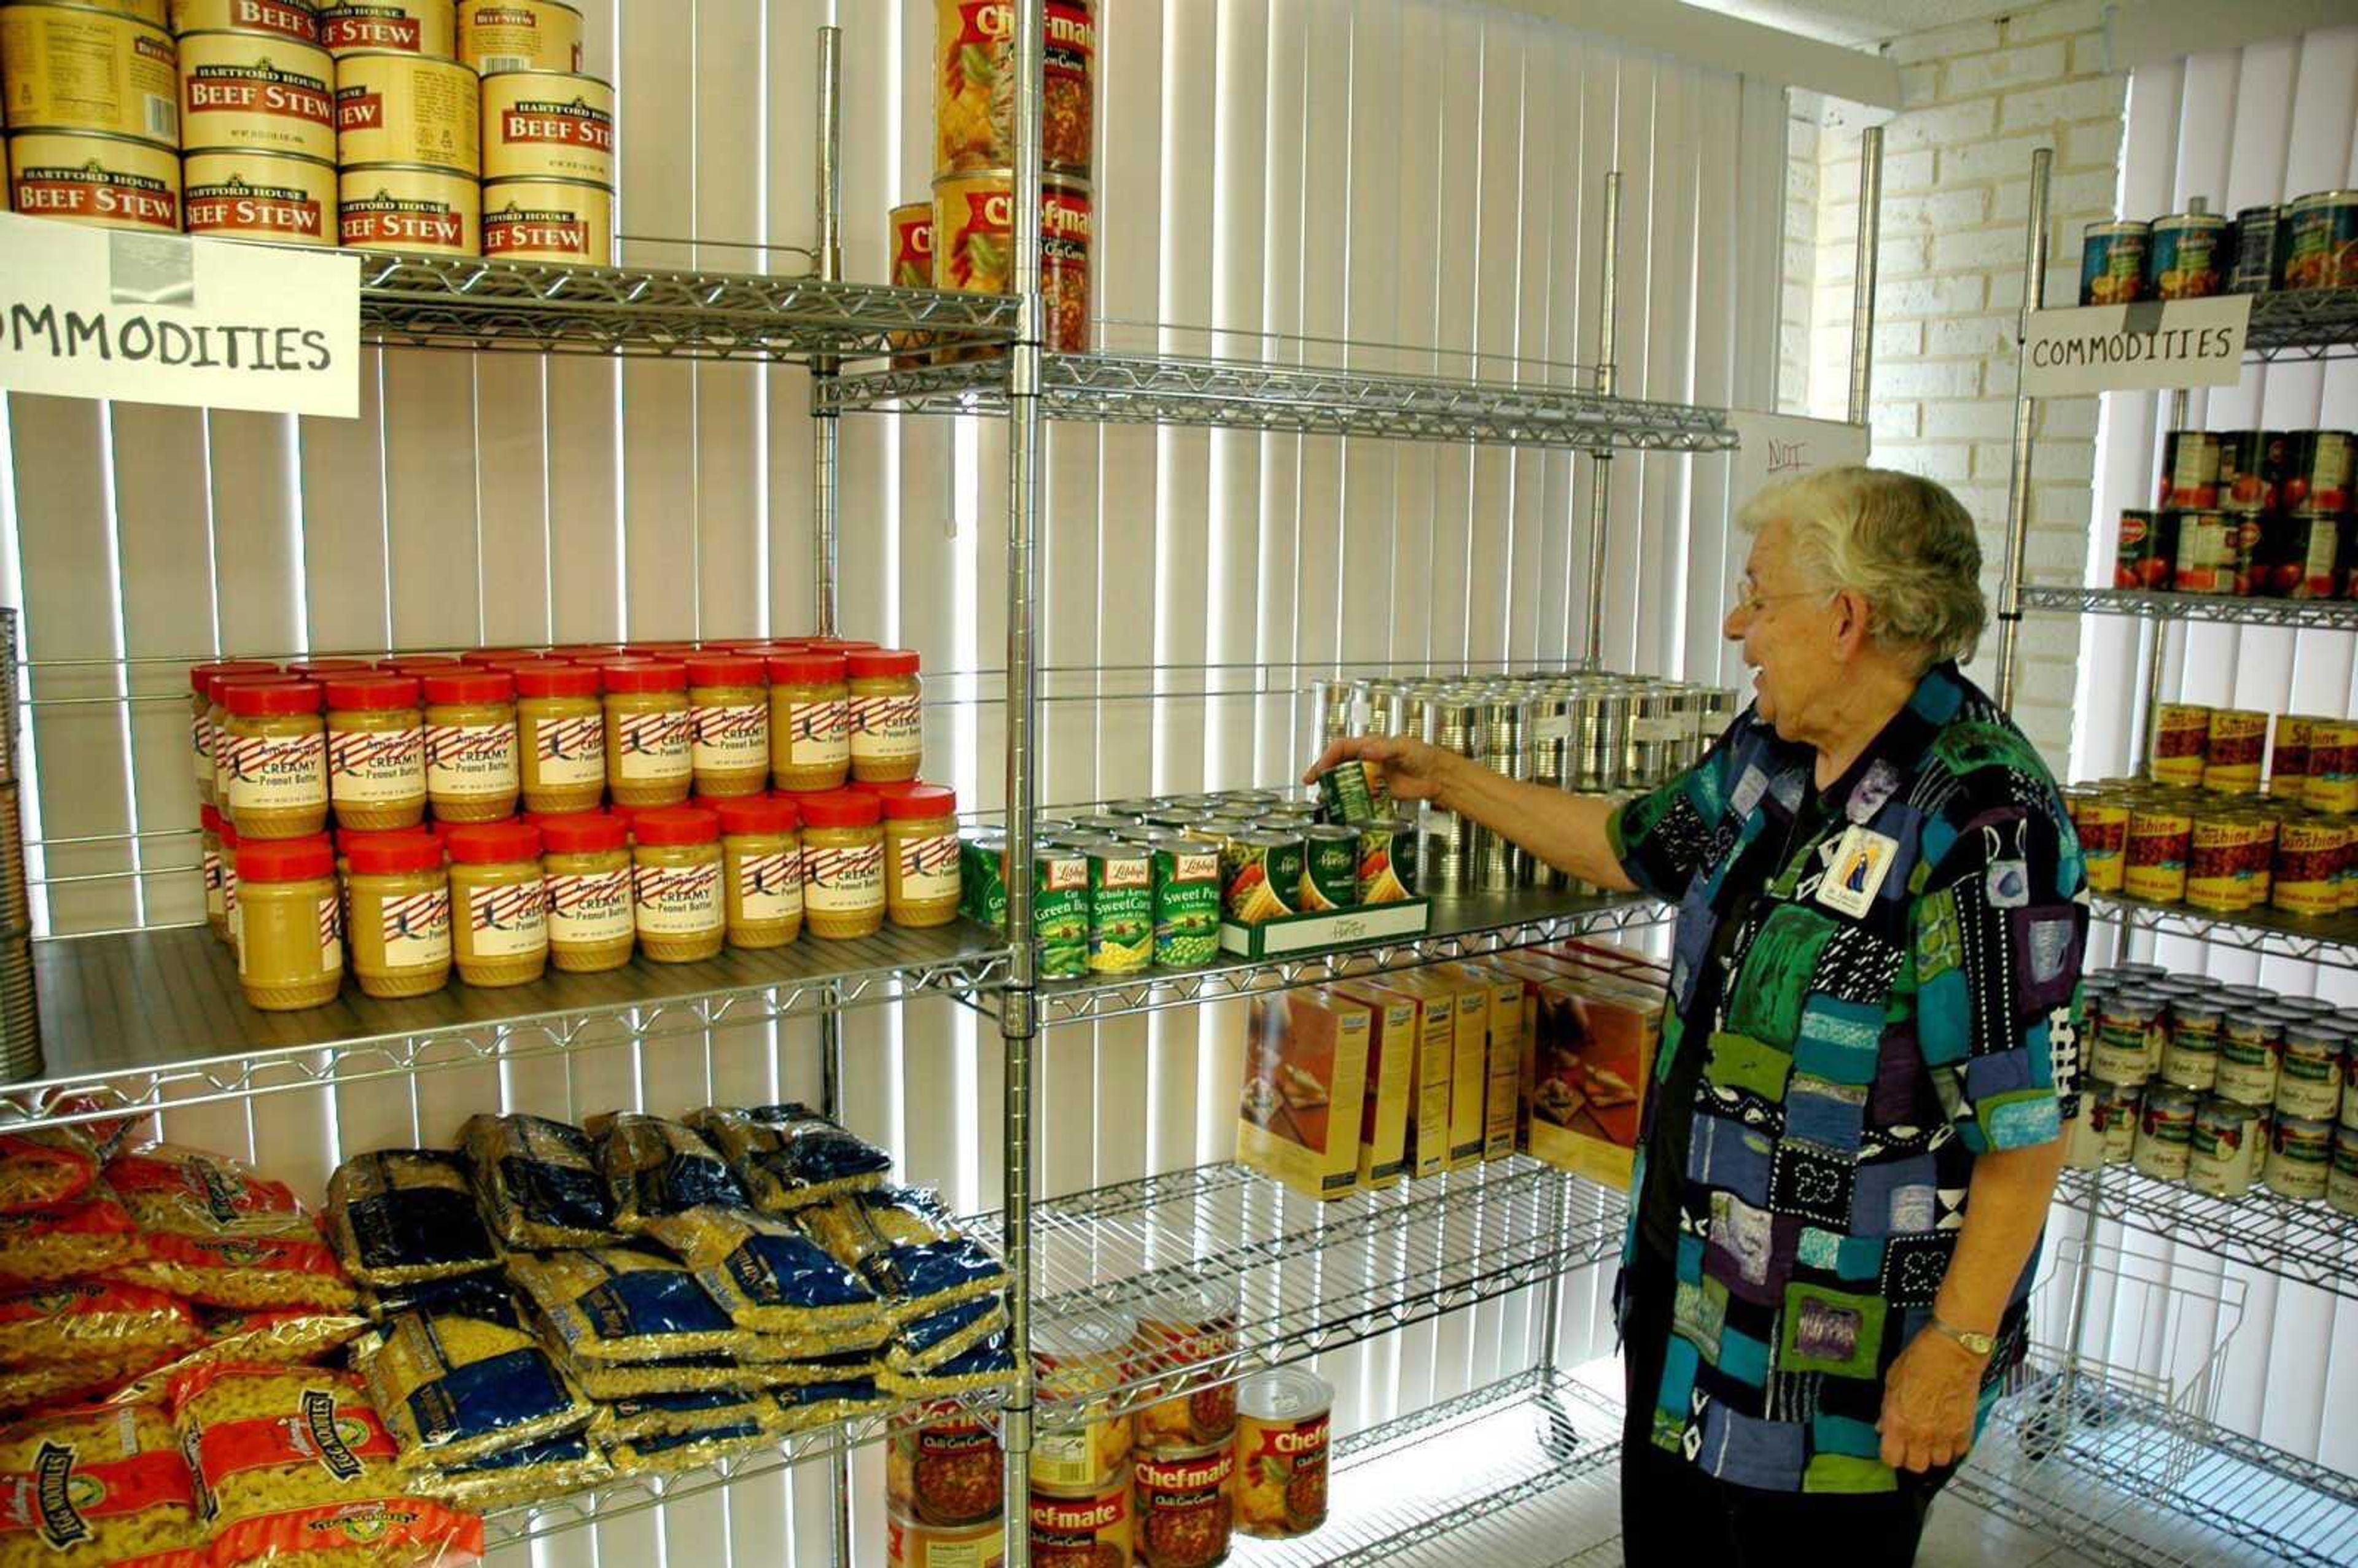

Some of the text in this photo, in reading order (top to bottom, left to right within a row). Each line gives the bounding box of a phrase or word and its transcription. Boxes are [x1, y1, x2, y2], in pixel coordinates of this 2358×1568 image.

[239, 1, 303, 32] BEEF
[341, 20, 414, 44] STEW
[200, 68, 279, 81] HARTFORD
[190, 83, 332, 118] BEEF STEW
[519, 104, 590, 117] HARTFORD
[508, 117, 573, 138] BEEF
[25, 169, 109, 183] HARTFORD
[20, 186, 173, 219] BEEF STEW
[253, 188, 305, 200] HOUSE
[237, 200, 316, 229] STEW
[399, 201, 446, 213] HOUSE
[342, 215, 458, 239] EEF STEW
[512, 225, 581, 247] STEW
[0, 303, 332, 371] MMODITIES
[2033, 327, 2234, 368] COMMODITIES
[368, 755, 418, 769] CREAMY
[457, 749, 508, 762] CREAMY
[261, 761, 317, 775] CREAMY
[577, 895, 627, 909] CREAMY
[660, 889, 710, 902] CREAMY
[1162, 888, 1200, 906] Sweet
[1034, 902, 1072, 921] Green
[312, 1398, 354, 1469] EGG NOODLES
[1032, 1504, 1116, 1529] ef-mate
